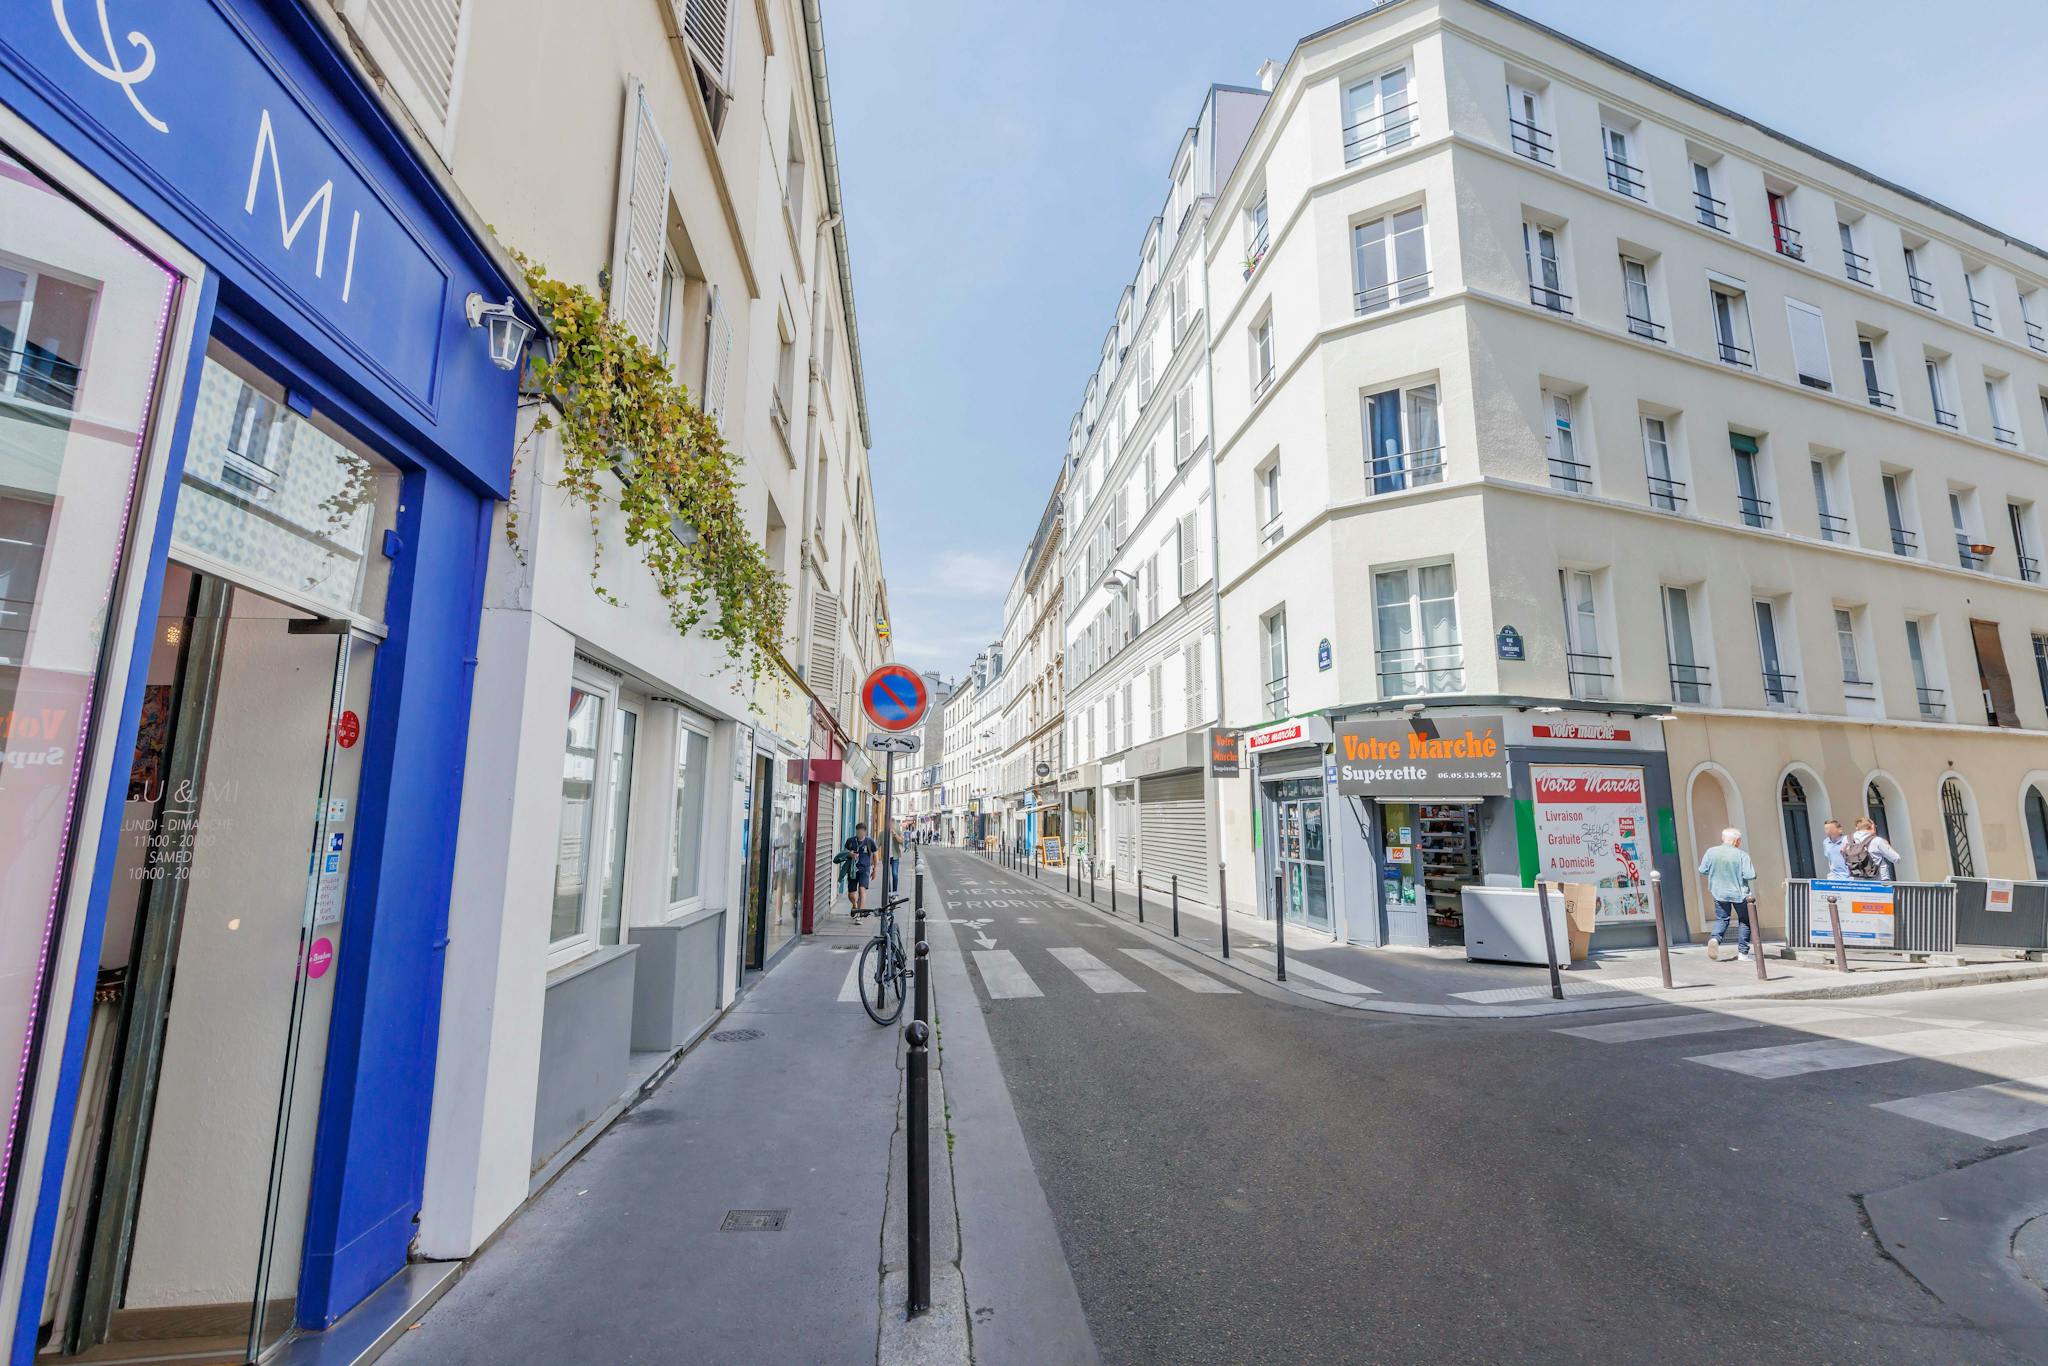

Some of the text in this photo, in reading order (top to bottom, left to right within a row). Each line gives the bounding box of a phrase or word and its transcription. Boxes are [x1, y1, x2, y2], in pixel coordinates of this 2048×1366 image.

[244, 108, 361, 304] MI
[1343, 728, 1497, 761] Votre Marché
[1342, 764, 1428, 784] Supérette
[1537, 769, 1577, 792] Votre
[174, 779, 198, 803] &
[1545, 810, 1584, 822] Livraison
[167, 819, 234, 832] DIMACHE
[133, 834, 170, 848] 11h00
[1548, 833, 1581, 846] Gratuite
[149, 850, 196, 864] SAMED
[1550, 855, 1595, 869] A Domicile
[129, 866, 165, 880] 10h00
